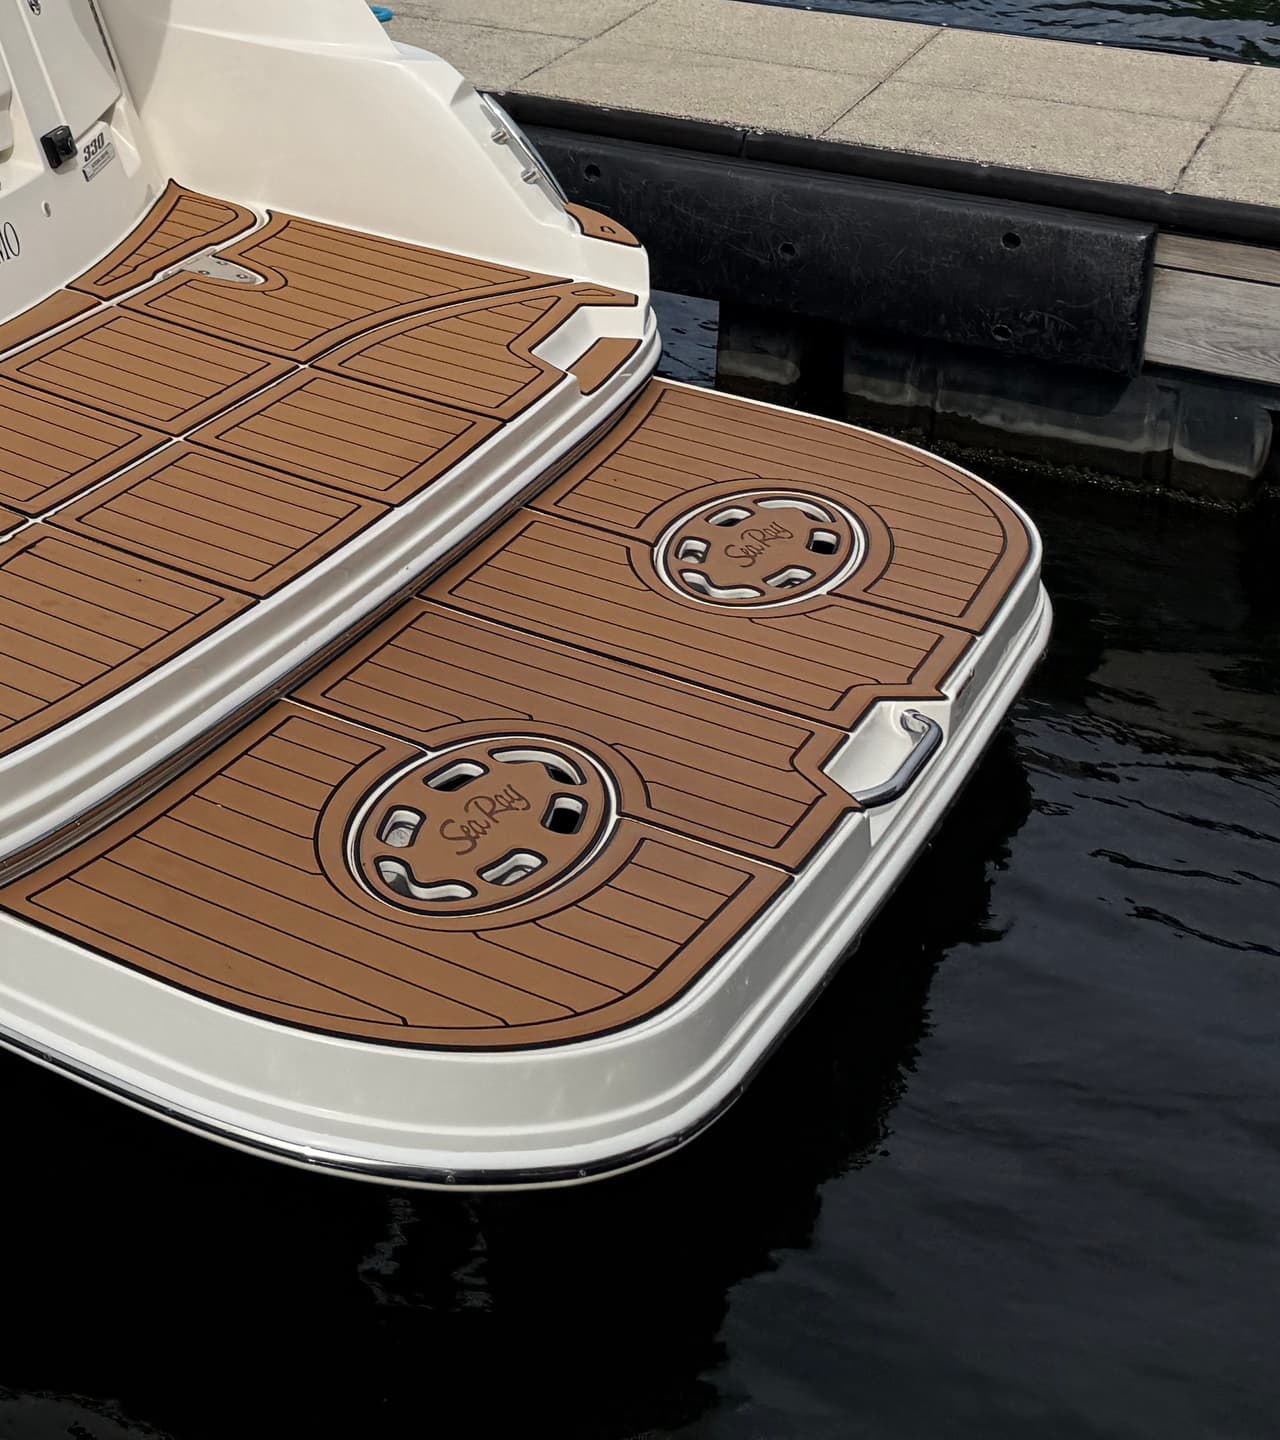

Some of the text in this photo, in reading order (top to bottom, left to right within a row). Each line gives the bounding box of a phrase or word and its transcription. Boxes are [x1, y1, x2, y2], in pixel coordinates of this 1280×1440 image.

[83, 132, 105, 162] 330
[724, 521, 795, 568] Sea Ray
[439, 783, 532, 856] Sea Ray
